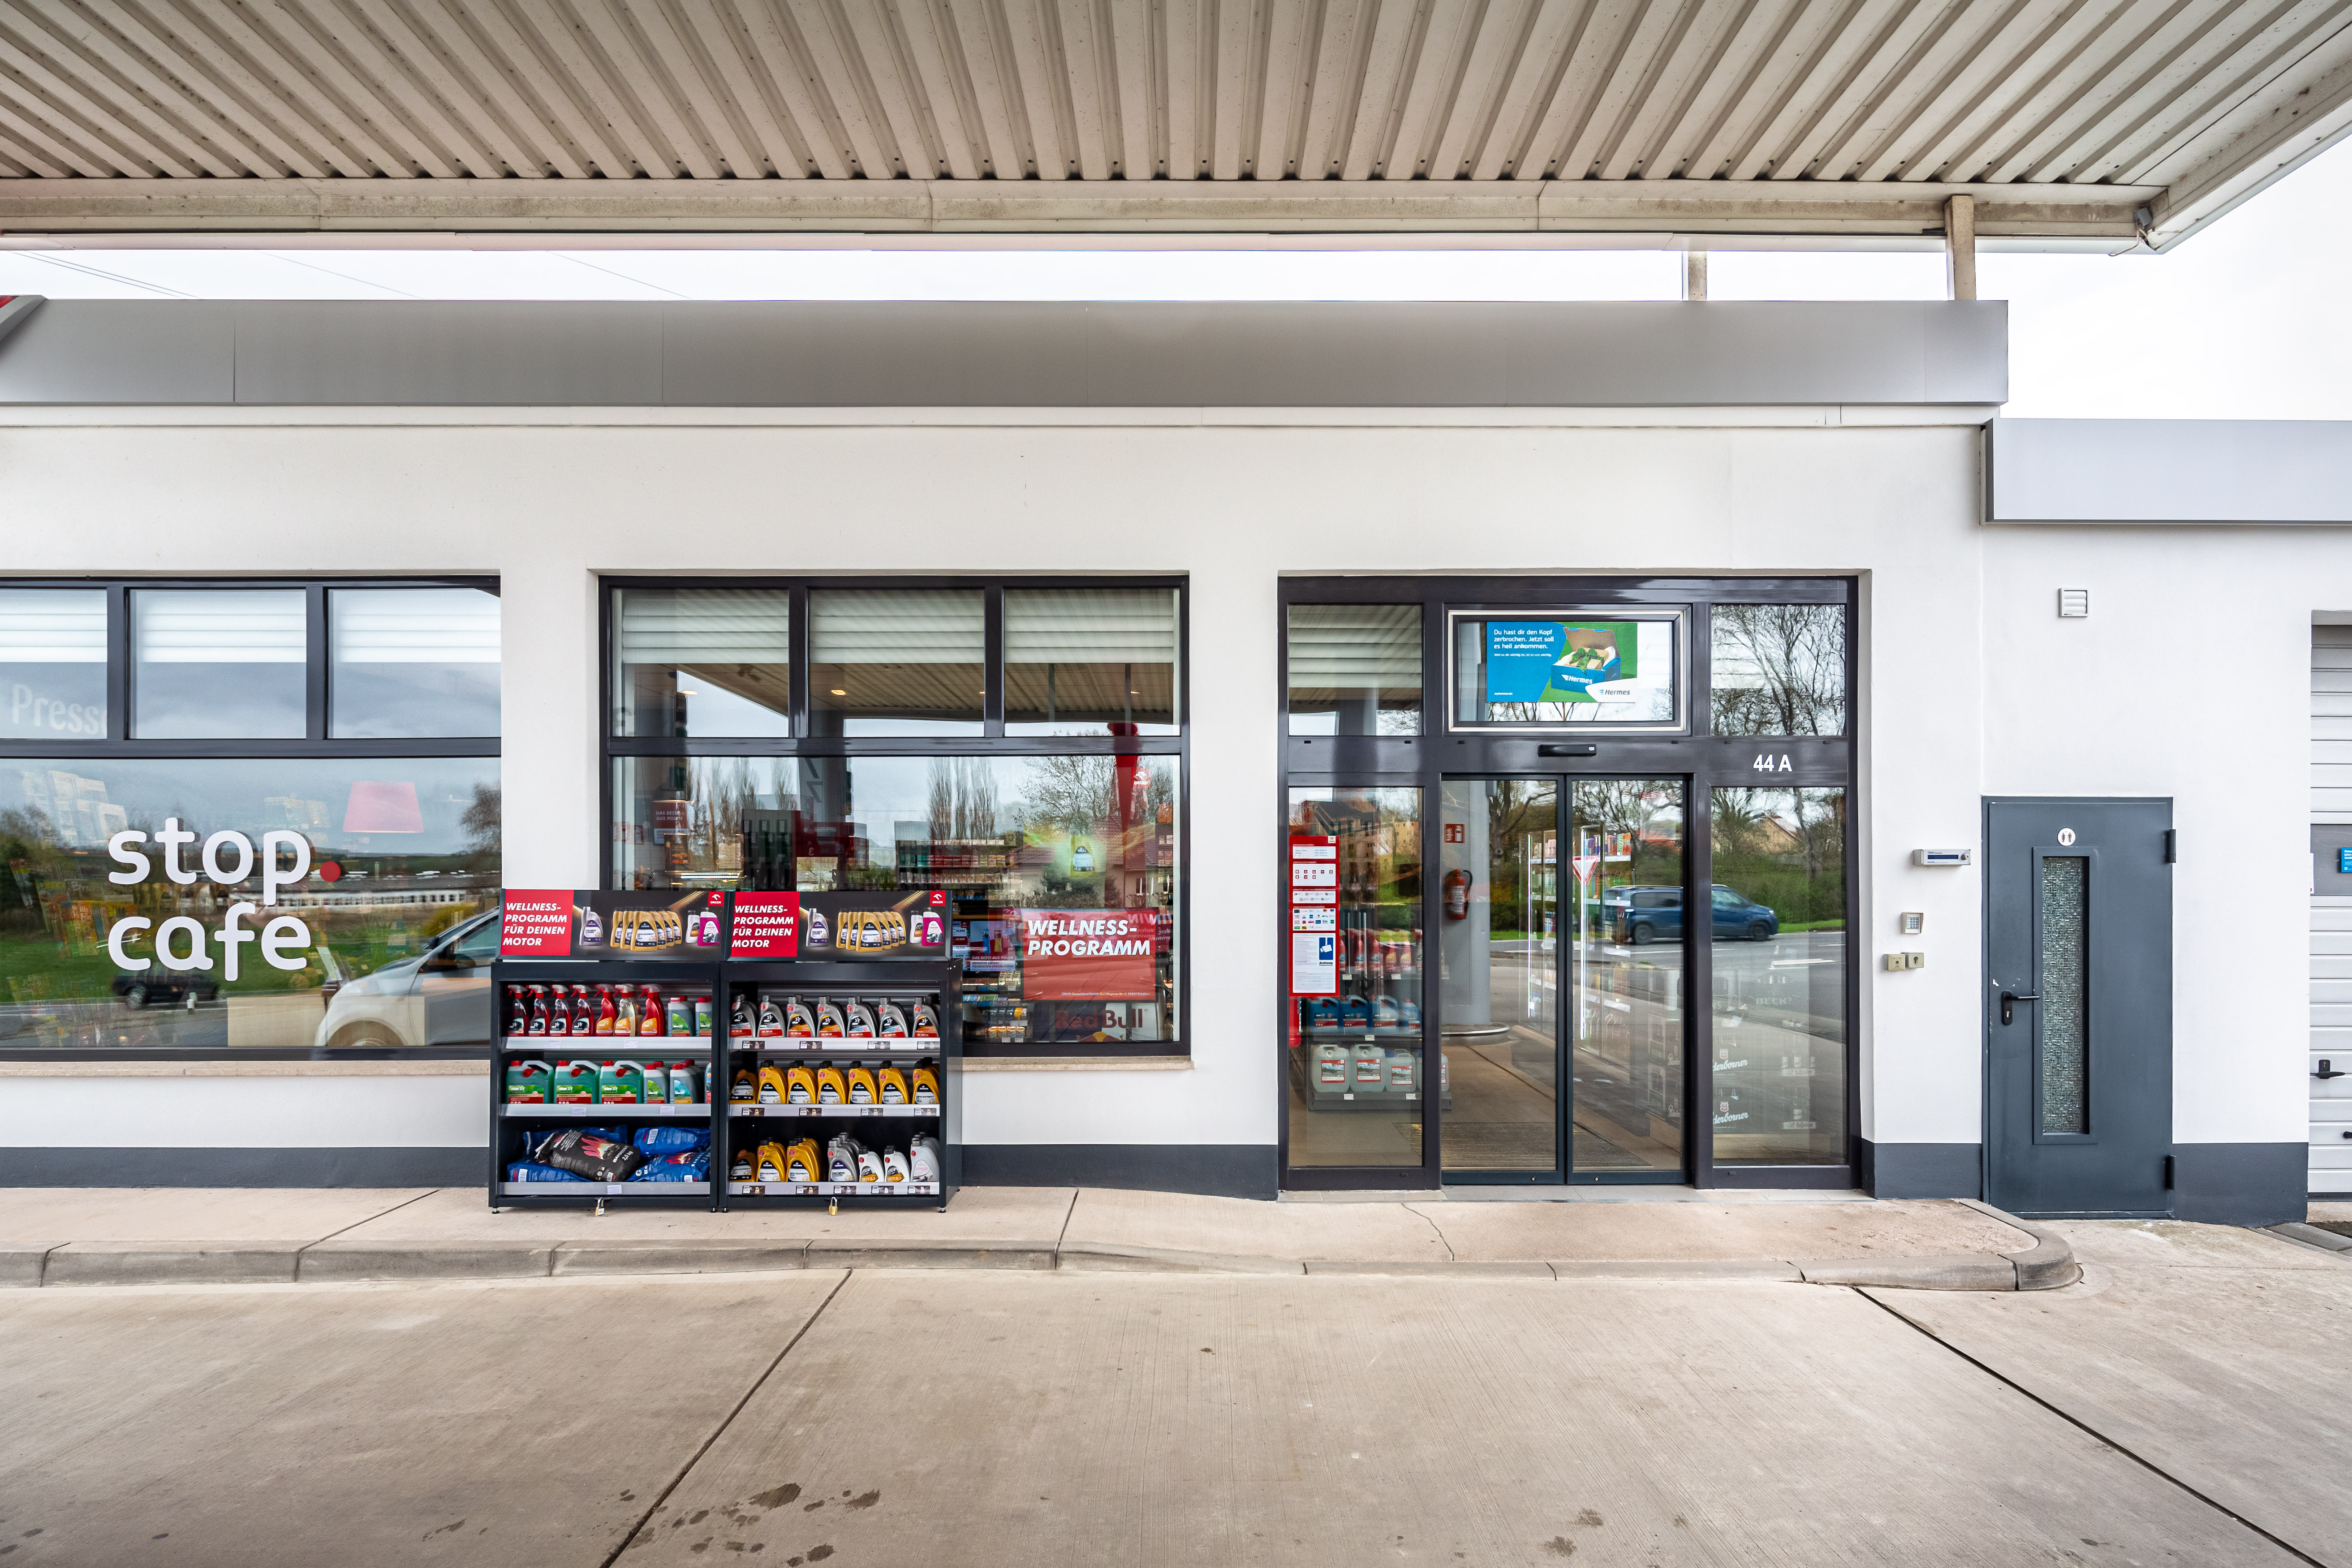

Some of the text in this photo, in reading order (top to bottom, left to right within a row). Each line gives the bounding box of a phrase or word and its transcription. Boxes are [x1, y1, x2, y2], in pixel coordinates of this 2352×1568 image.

[1568, 676, 1593, 684] Hermes
[1753, 754, 1792, 771] 44 A
[506, 903, 561, 911] WELLNESS-
[735, 905, 788, 913] WELLNESS-
[505, 914, 567, 923] PROGRAMM
[734, 917, 793, 925] PROGRAMM
[504, 924, 565, 935] FÜR DEINEN
[733, 926, 792, 936] FÜR DEINEN
[1028, 920, 1137, 935] WELLNESS-
[108, 902, 311, 982] cafe
[503, 937, 542, 946] MOTOR
[732, 939, 770, 948] MOTOR
[1028, 940, 1150, 956] PROGRAMM
[1056, 1009, 1098, 1029] Red
